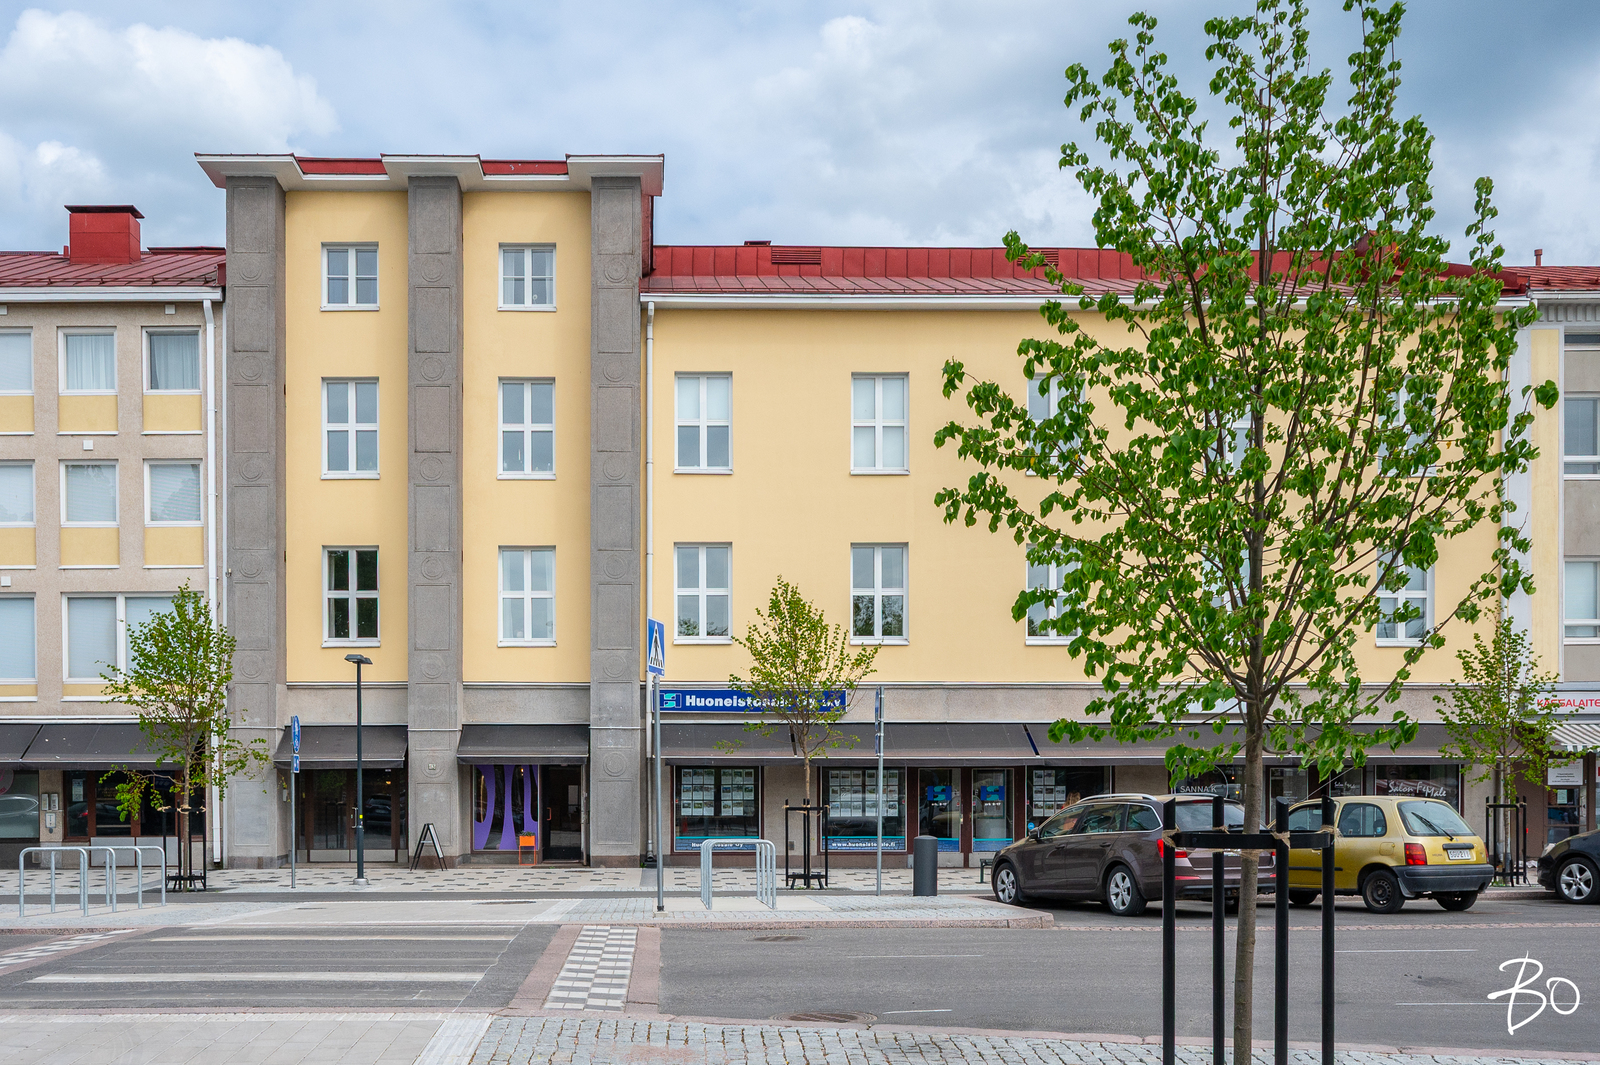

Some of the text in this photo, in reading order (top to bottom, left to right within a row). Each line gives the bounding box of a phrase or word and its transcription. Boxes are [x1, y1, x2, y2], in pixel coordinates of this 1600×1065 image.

[1180, 785, 1217, 793] SANNA K
[1388, 780, 1414, 793] Salon
